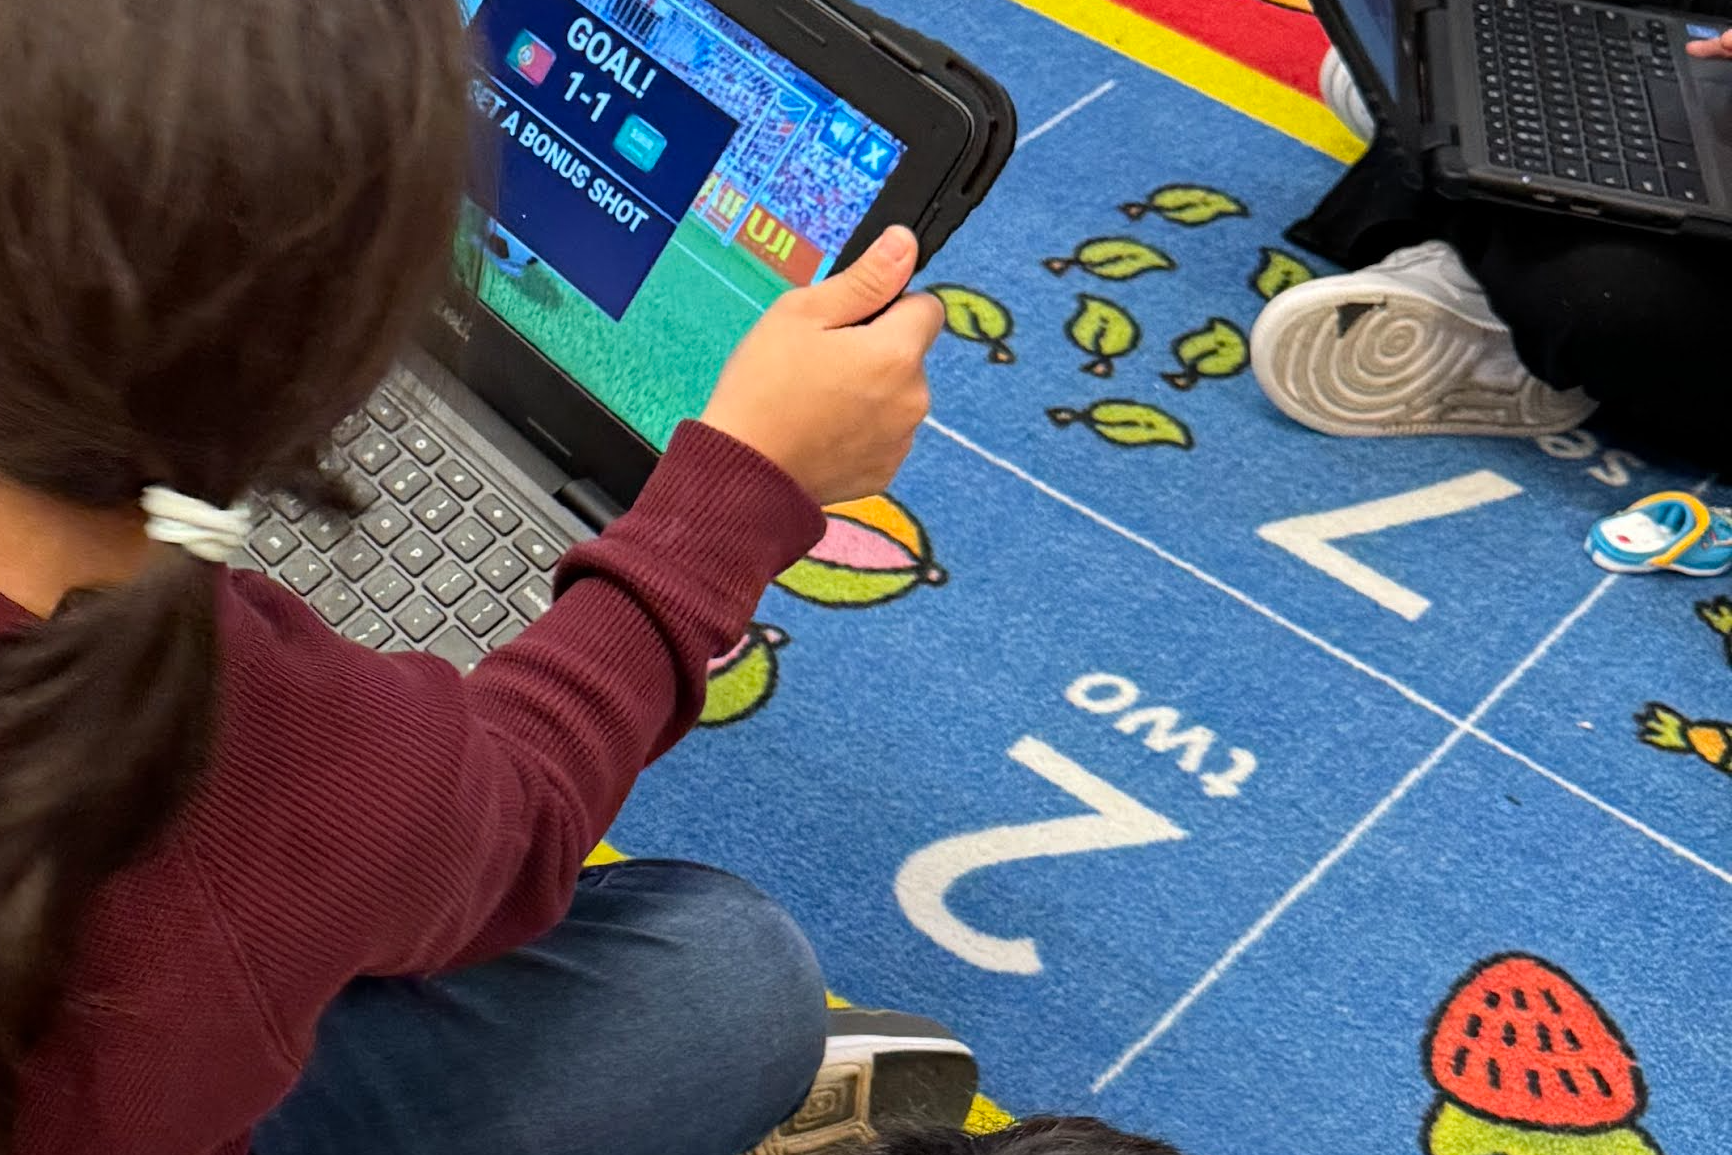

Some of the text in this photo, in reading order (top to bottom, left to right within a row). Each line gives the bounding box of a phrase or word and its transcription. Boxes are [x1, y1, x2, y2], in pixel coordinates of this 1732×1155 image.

[564, 72, 611, 122] 1-1
[567, 17, 657, 99] GOAL!
[500, 110, 520, 136] A
[518, 121, 591, 189] BONUS
[588, 178, 650, 233] SHOT
[1256, 468, 1524, 623] 7
[1065, 672, 1259, 798] two
[893, 734, 1191, 976] 2
